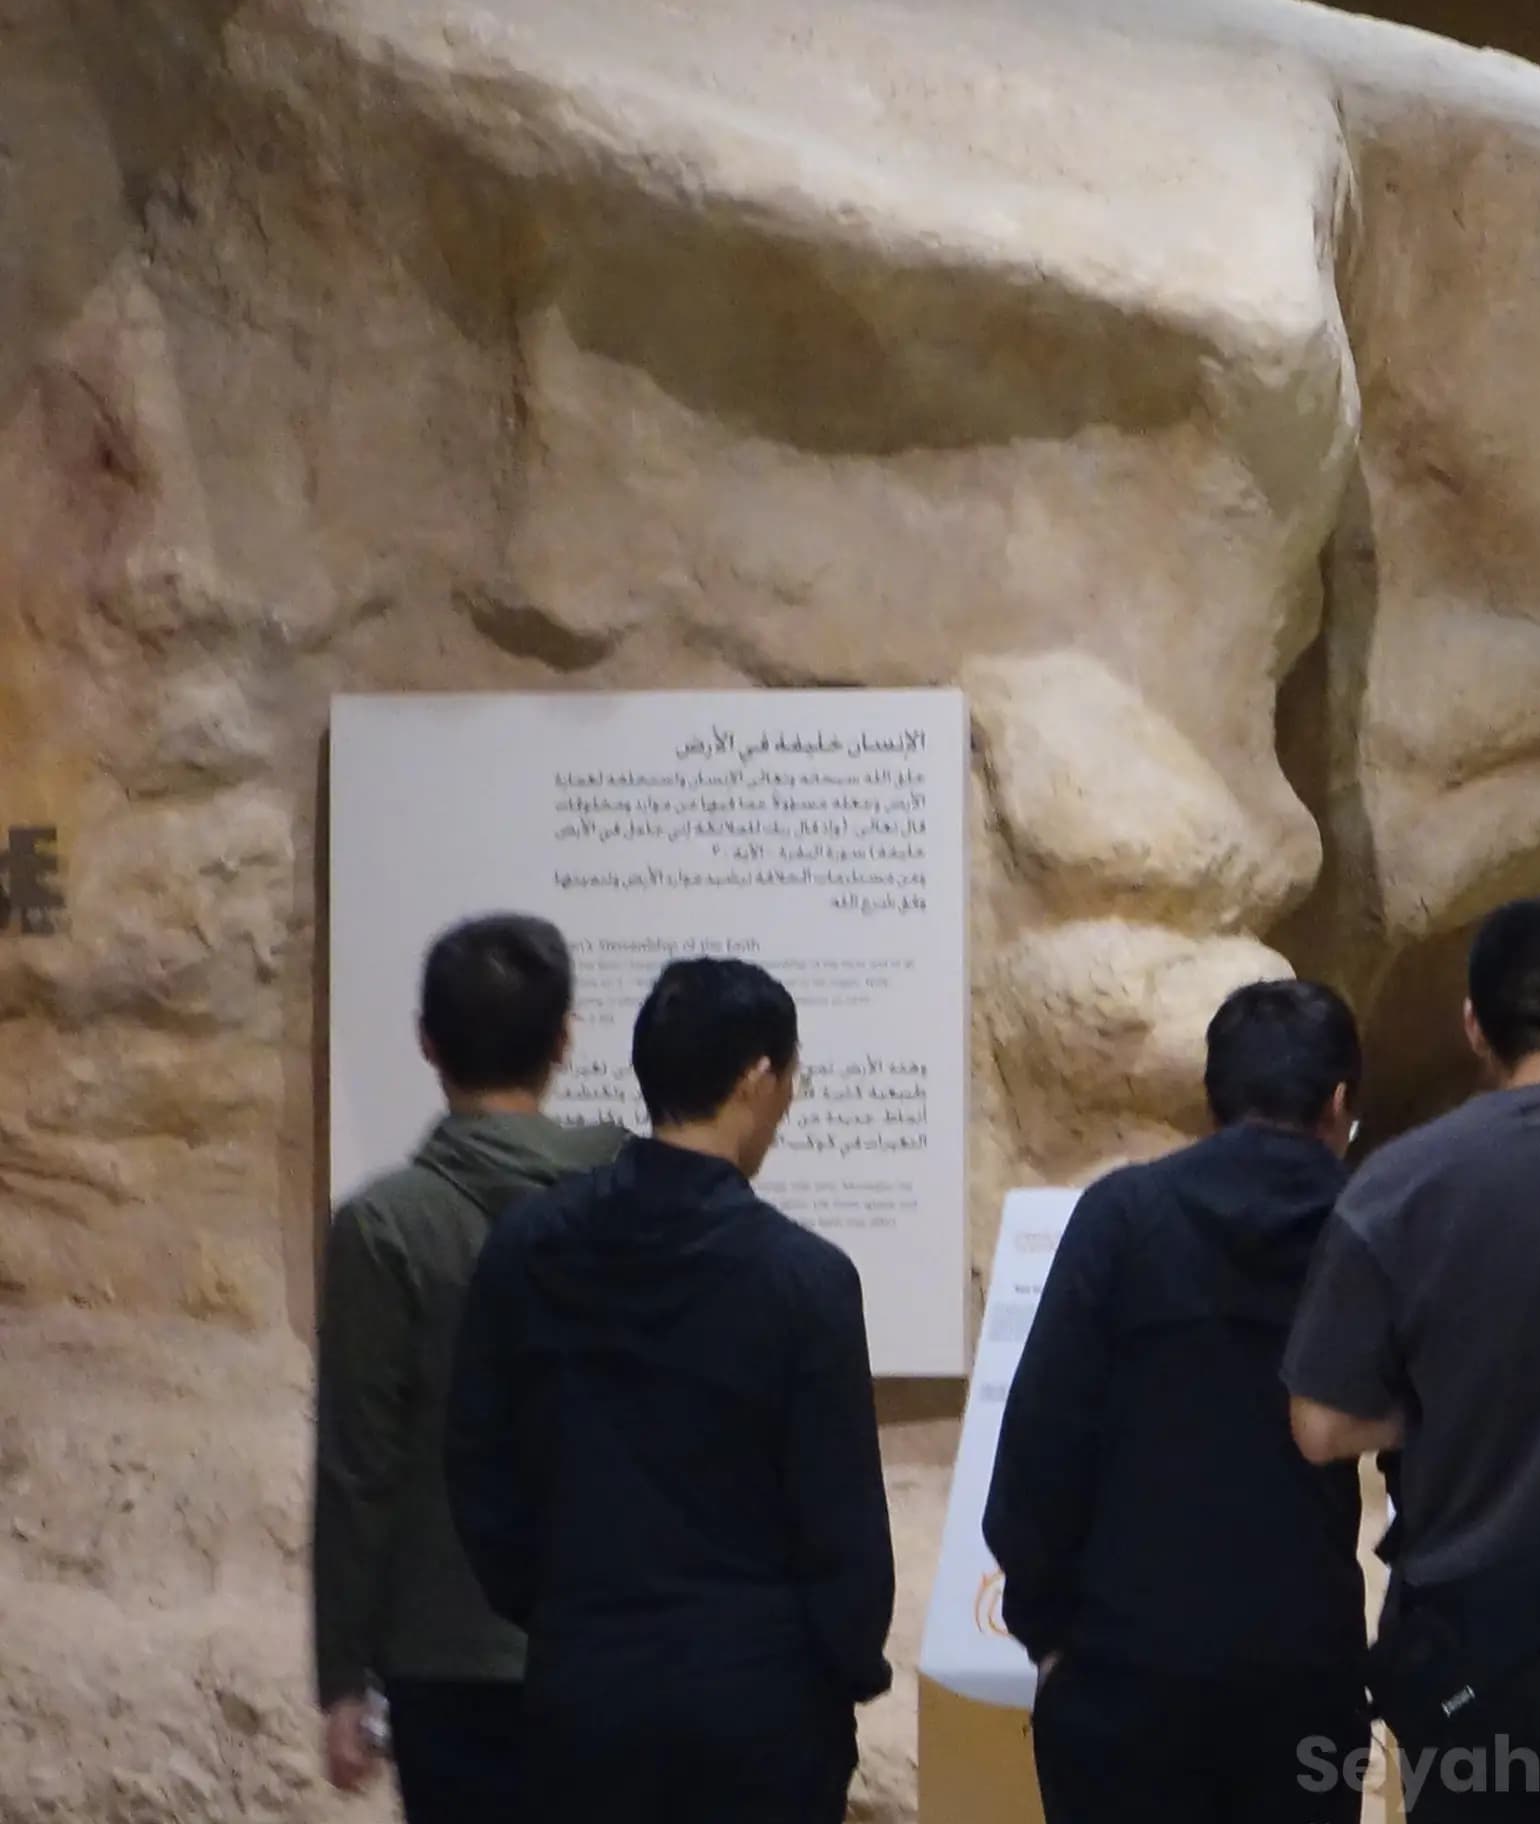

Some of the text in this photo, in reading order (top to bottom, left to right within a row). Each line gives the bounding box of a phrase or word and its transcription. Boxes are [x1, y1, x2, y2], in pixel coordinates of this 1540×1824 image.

[676, 724, 926, 767] الإنسان خليفة في الأرض
